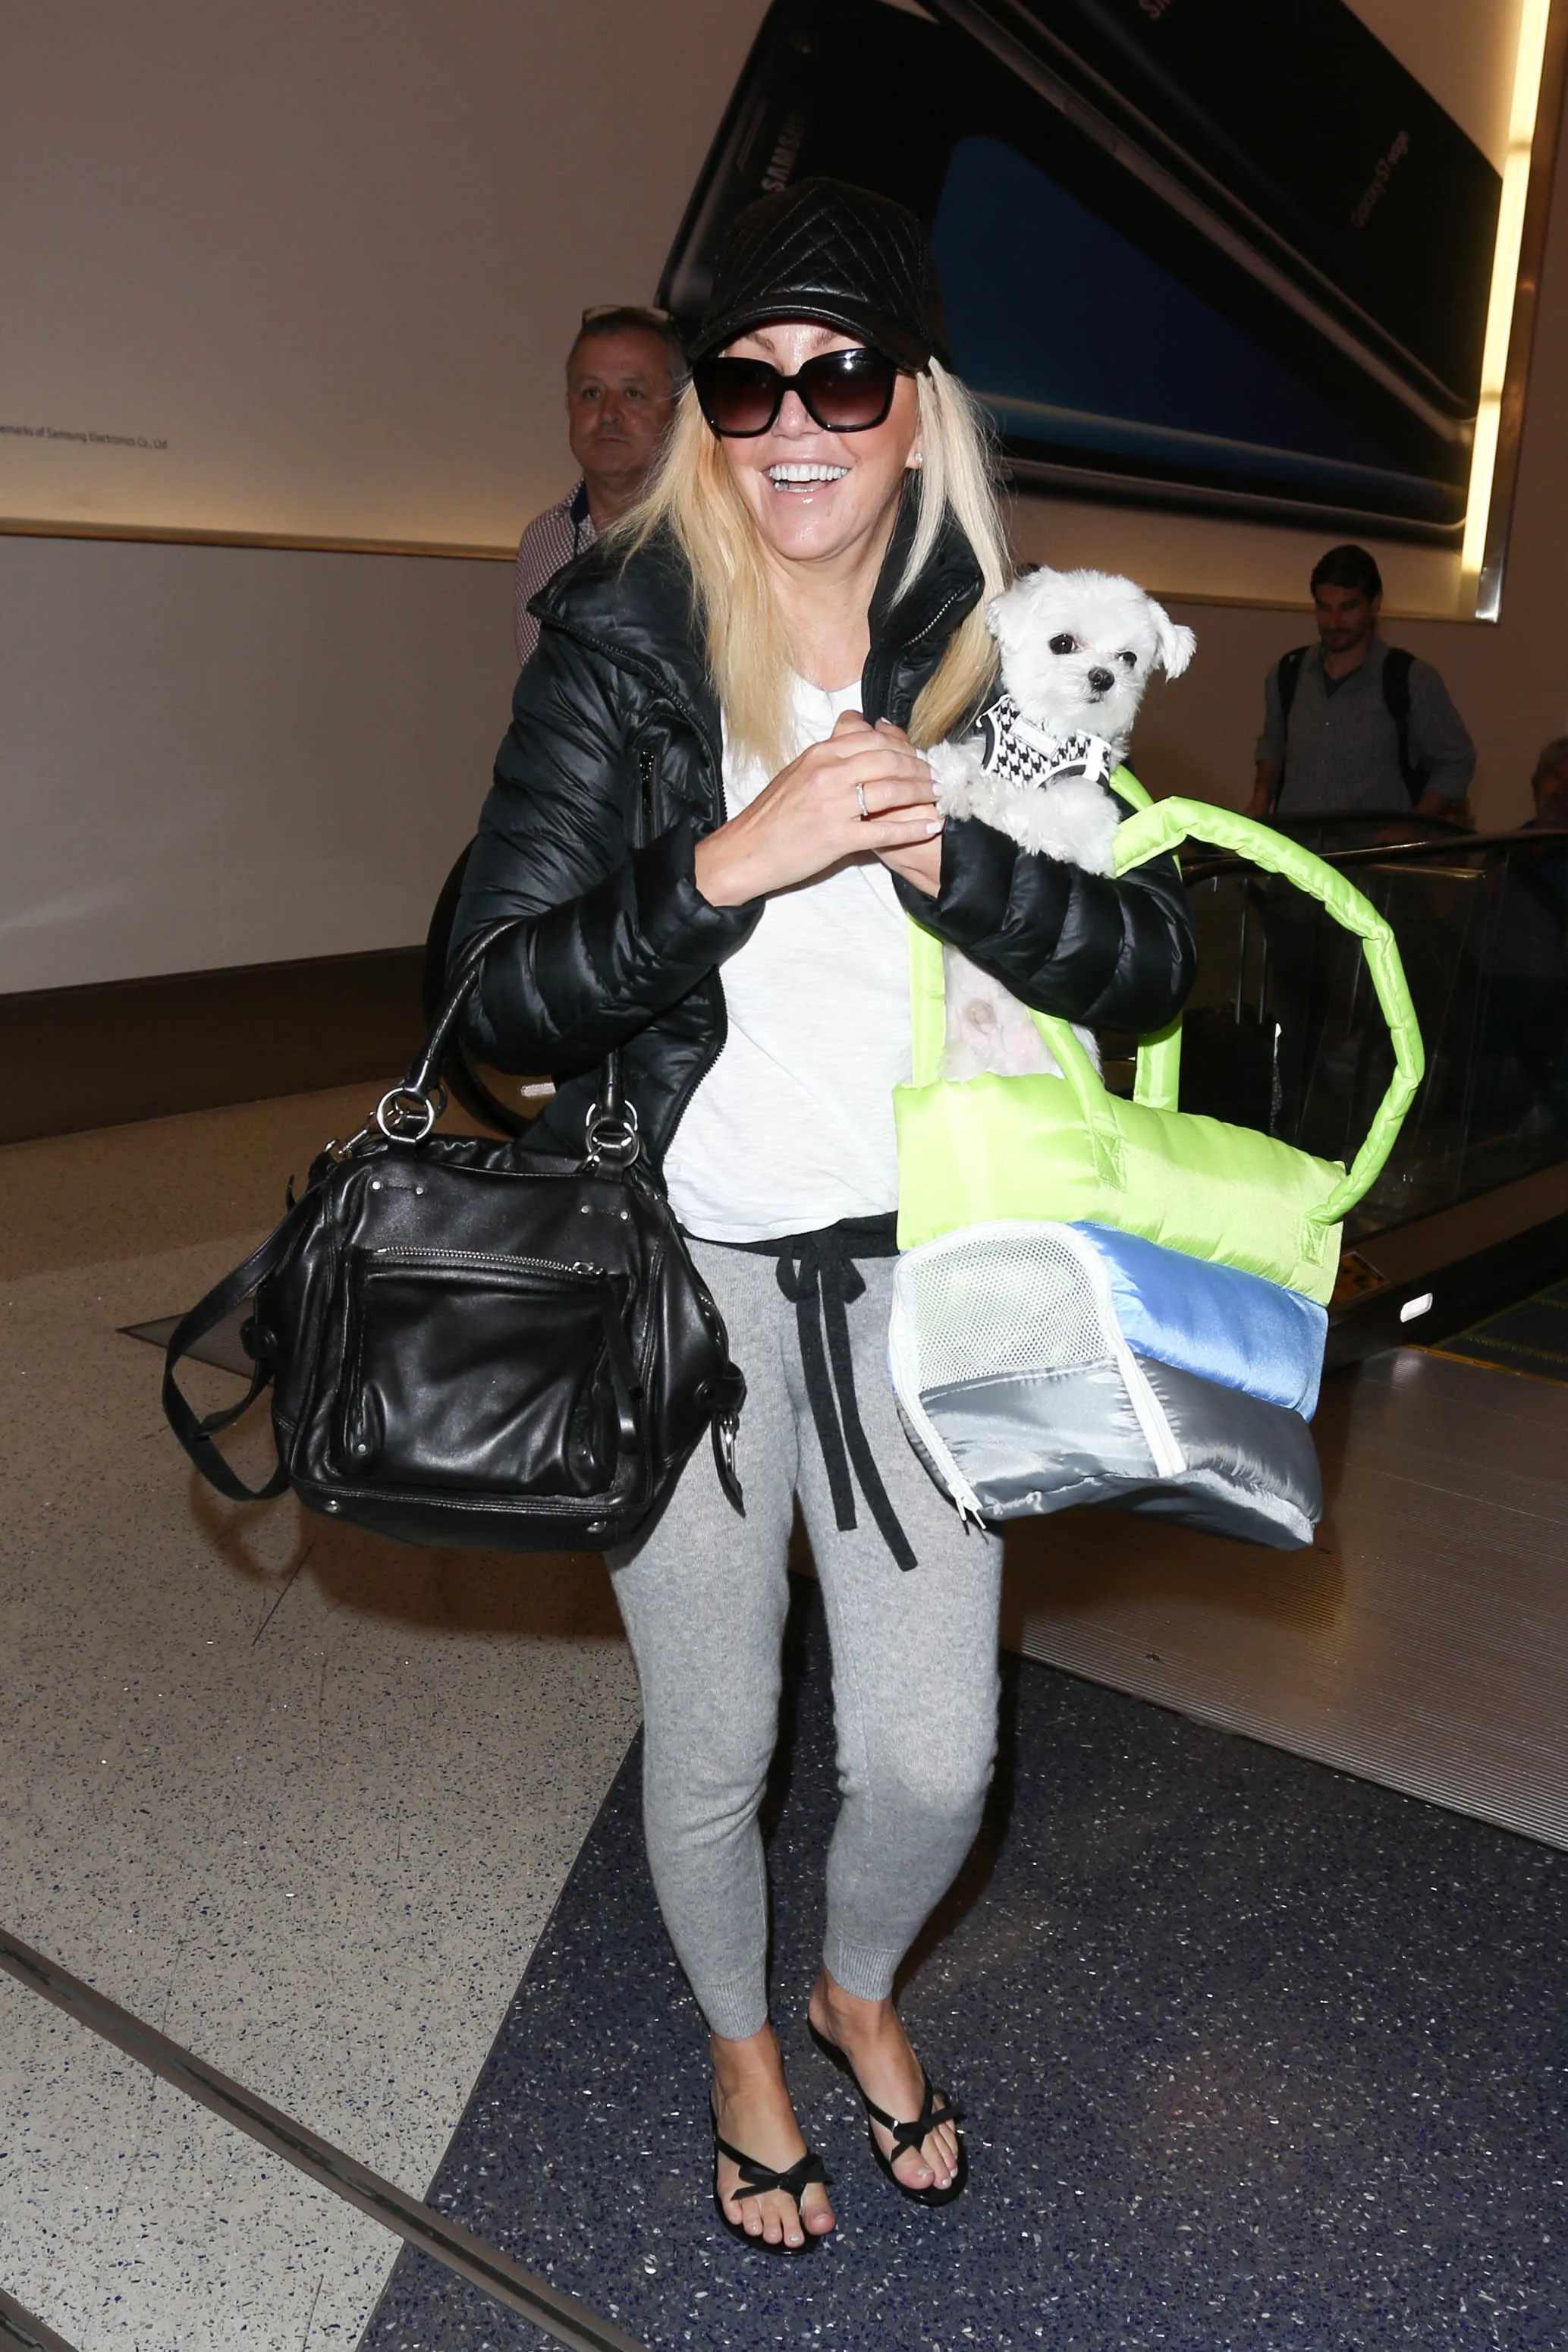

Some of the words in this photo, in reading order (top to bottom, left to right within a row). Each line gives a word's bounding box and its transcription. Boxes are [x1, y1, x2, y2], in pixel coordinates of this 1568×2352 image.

[36, 426, 45, 437] of
[46, 427, 87, 444] Samsung
[89, 431, 135, 447] Electronics
